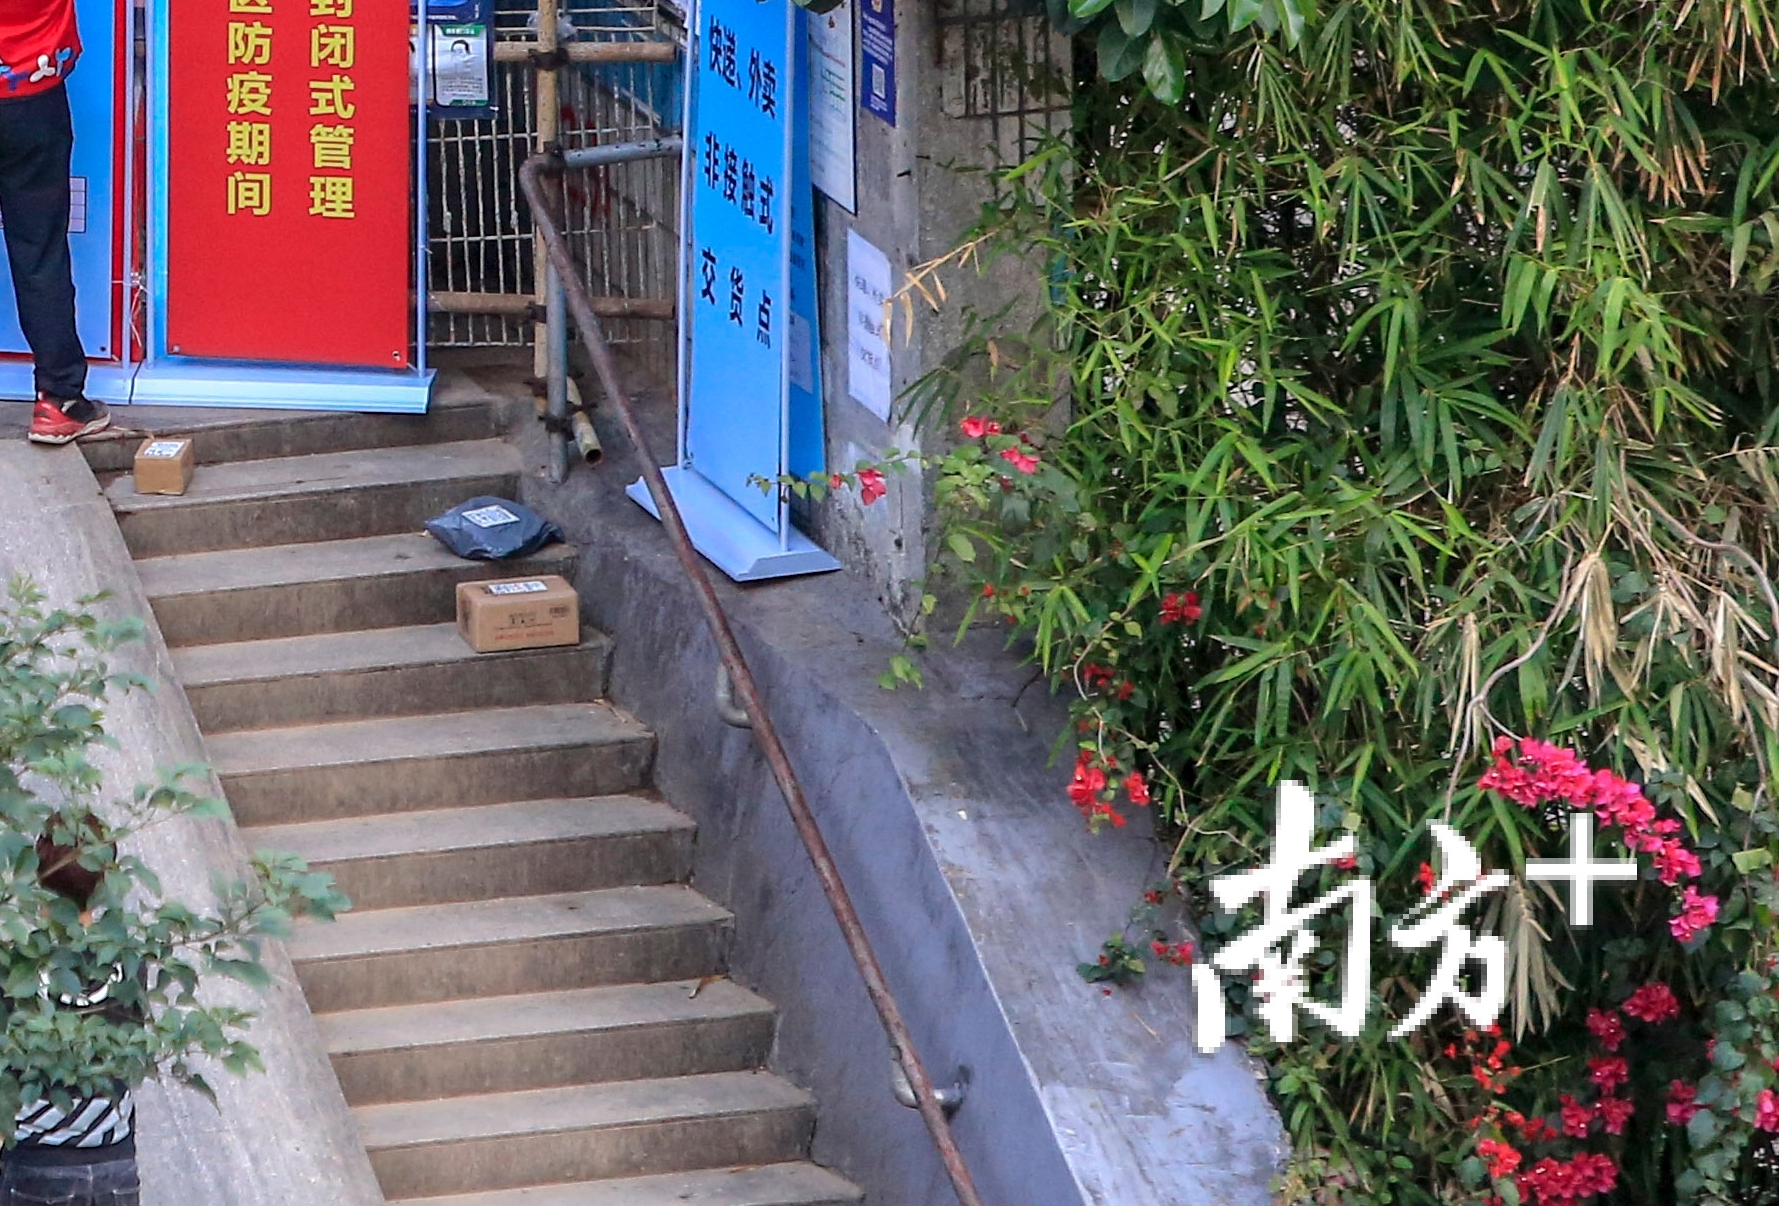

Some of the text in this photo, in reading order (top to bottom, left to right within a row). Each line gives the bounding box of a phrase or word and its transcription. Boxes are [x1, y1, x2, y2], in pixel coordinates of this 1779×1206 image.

[708, 14, 777, 120] 快递、外卖
[703, 129, 775, 235] 非接触式
[700, 246, 773, 351] 交货点
